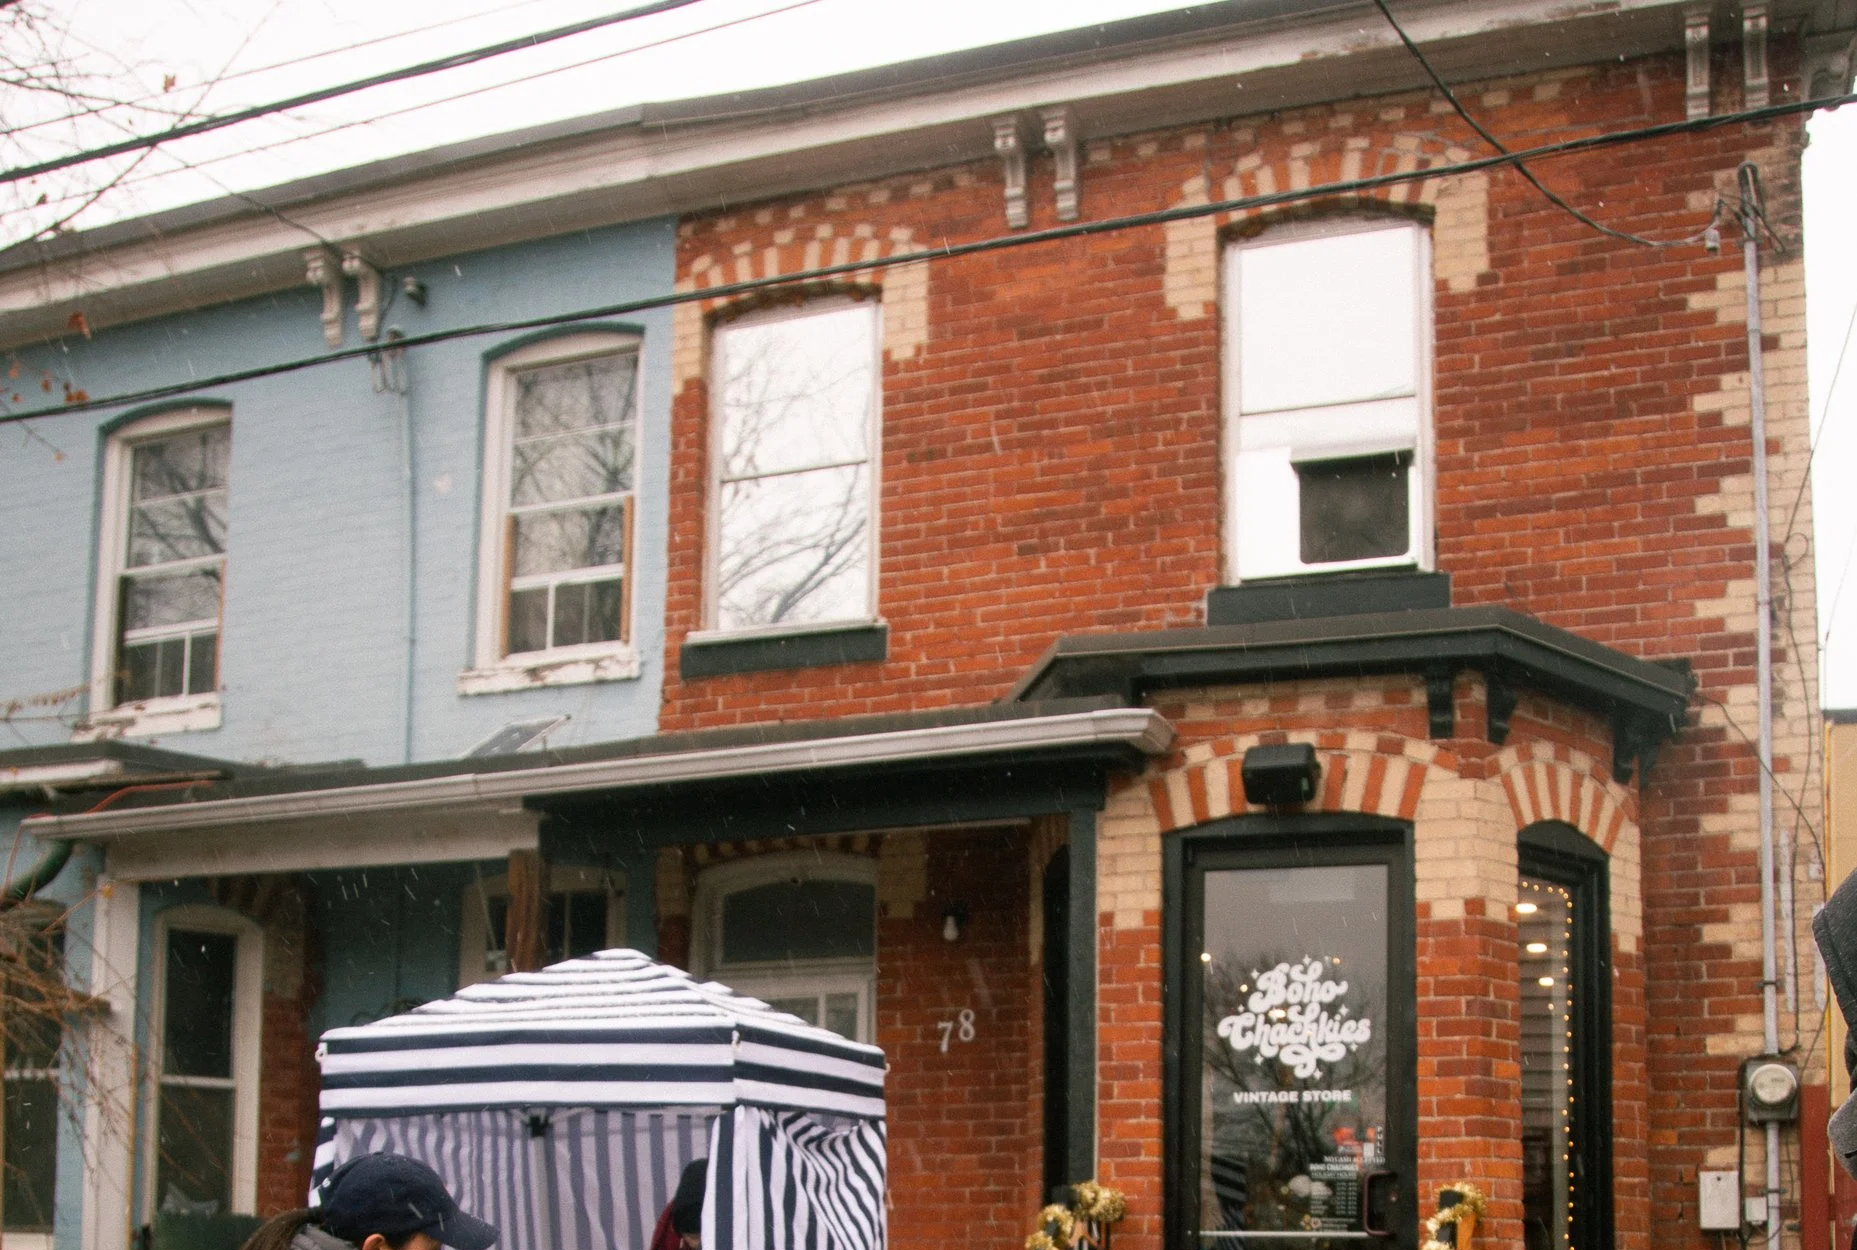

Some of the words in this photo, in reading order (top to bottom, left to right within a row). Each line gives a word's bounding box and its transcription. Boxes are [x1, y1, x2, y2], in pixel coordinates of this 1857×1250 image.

[1248, 960, 1349, 1014] Boho
[936, 1008, 976, 1054] 78
[1217, 1002, 1371, 1079] Chachkies
[1233, 1090, 1299, 1103] VINTAGE
[1302, 1089, 1353, 1102] STORE
